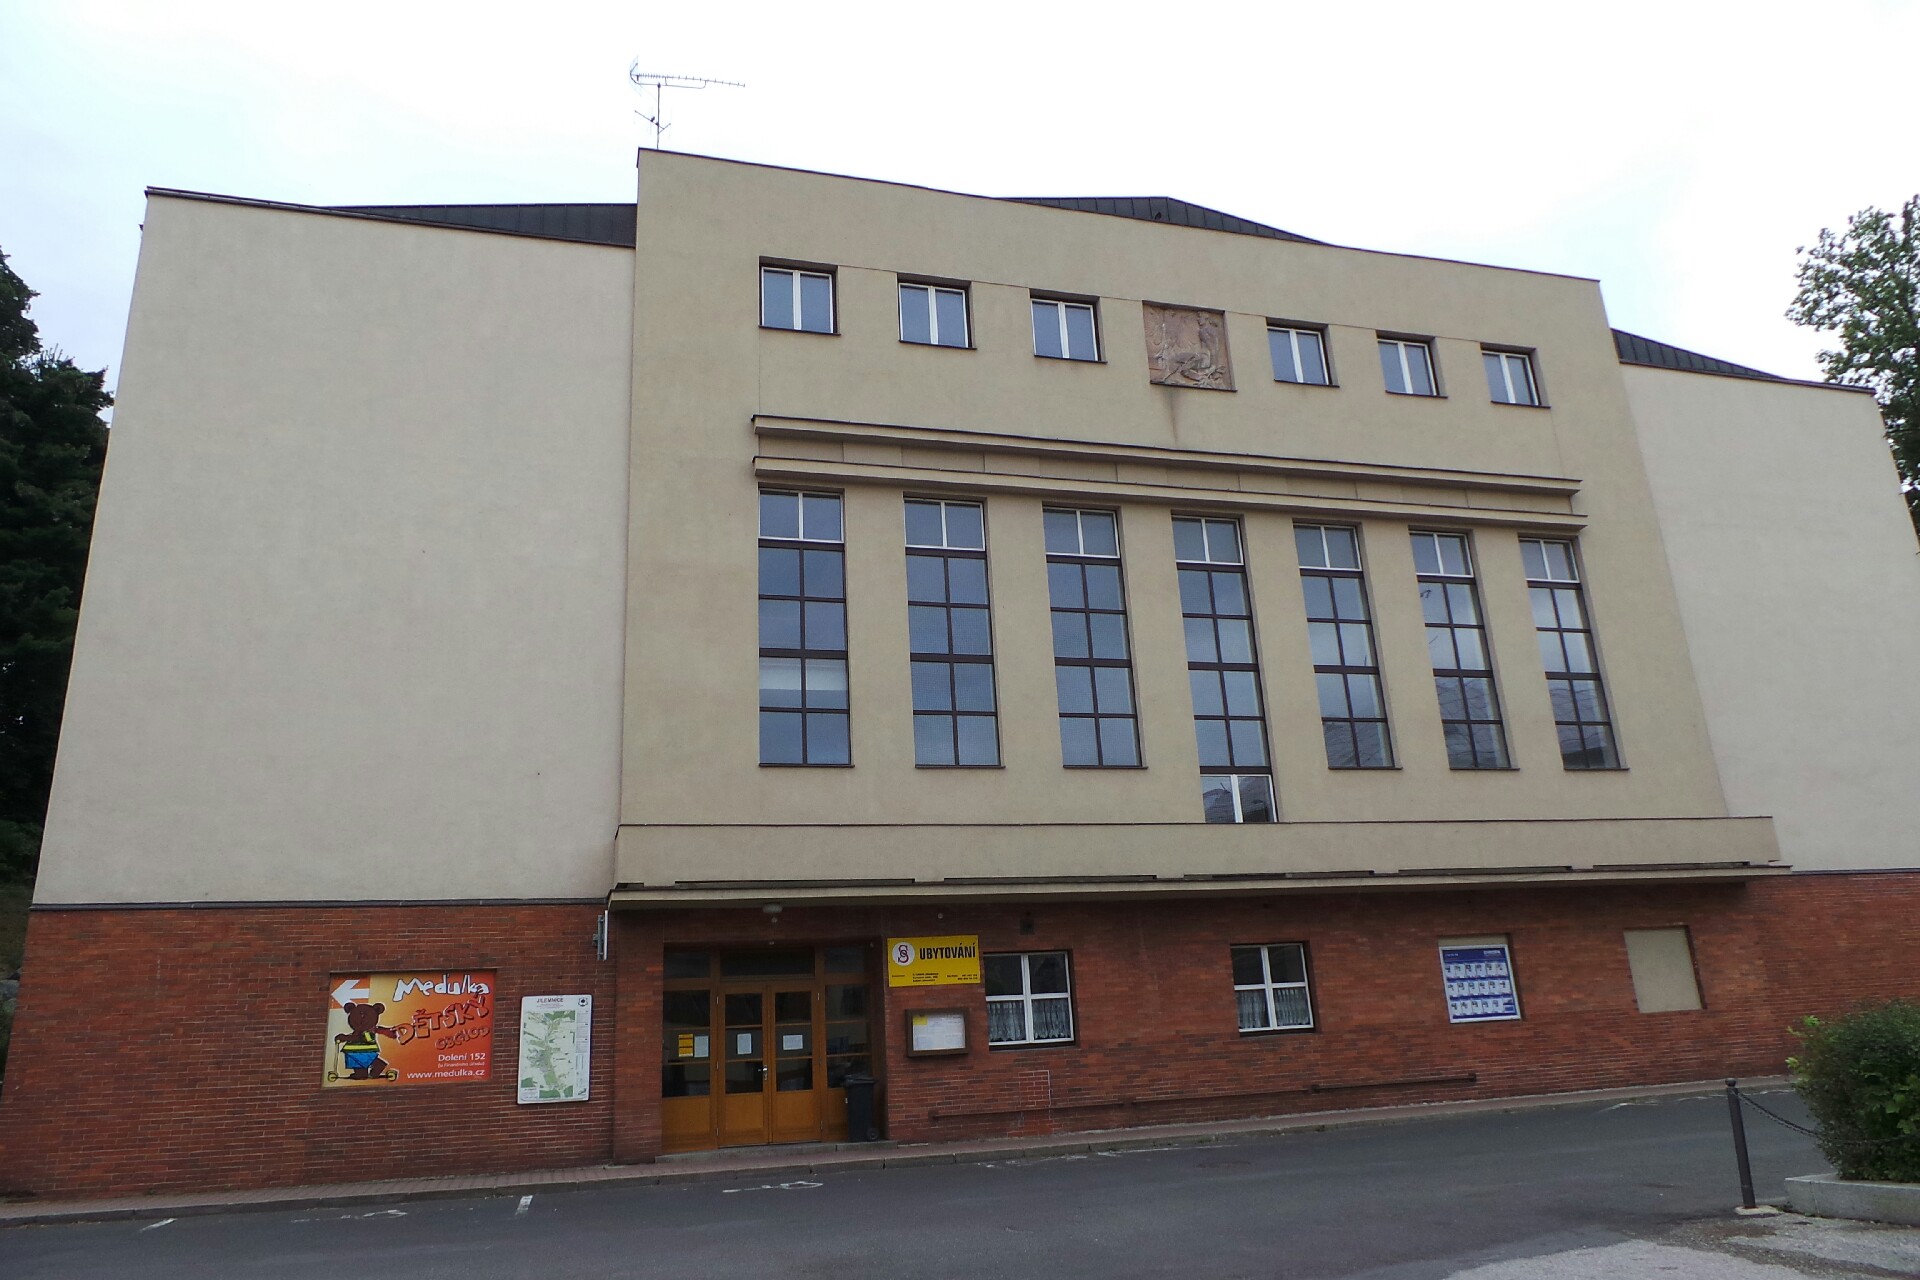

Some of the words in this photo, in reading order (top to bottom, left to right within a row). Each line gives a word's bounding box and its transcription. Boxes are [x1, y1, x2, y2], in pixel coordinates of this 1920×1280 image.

[920, 943, 975, 960] UBYTOVÁNÍ
[396, 994, 489, 1045] DĚTSKÝ
[438, 1052, 467, 1062] Dolení
[470, 1052, 486, 1061] 152
[406, 1068, 486, 1079] www.medulka.cz
